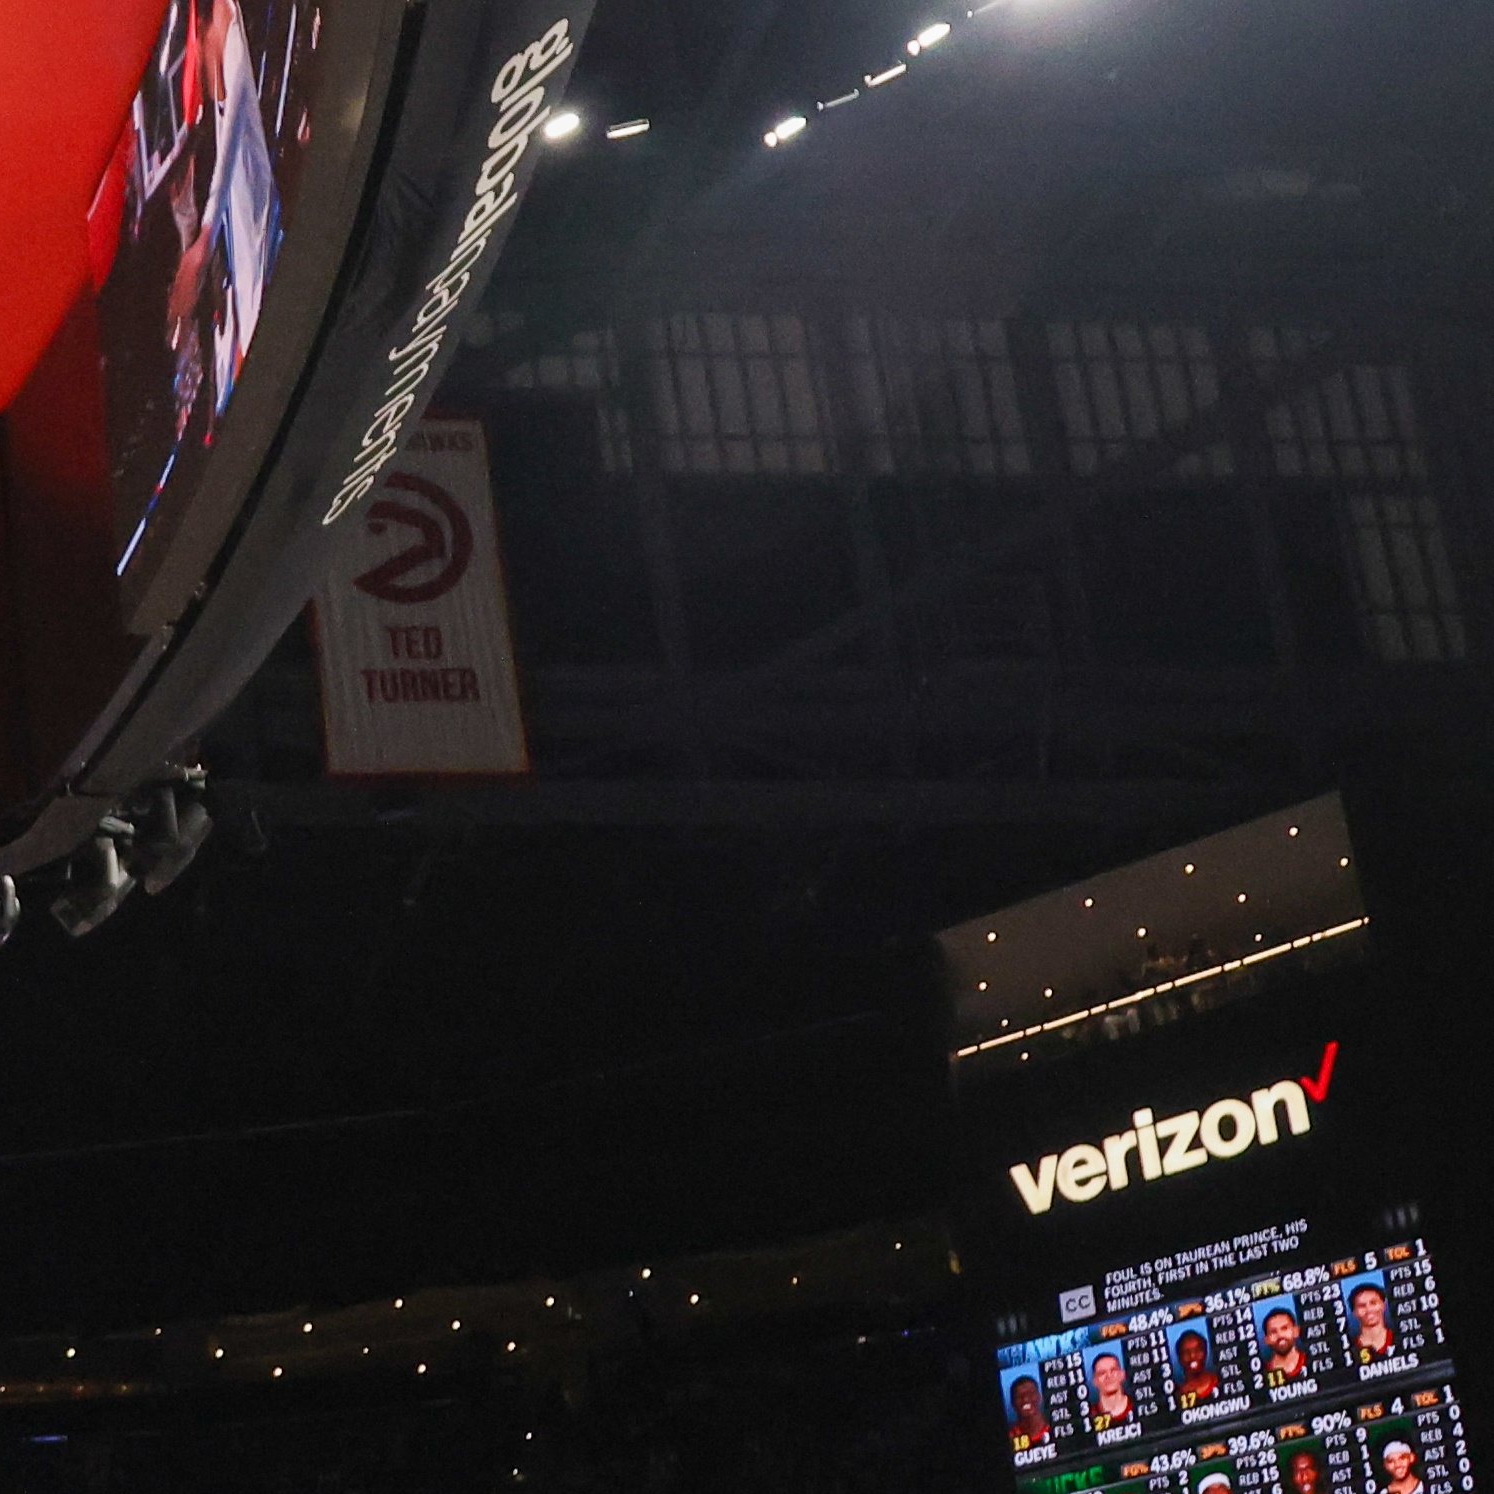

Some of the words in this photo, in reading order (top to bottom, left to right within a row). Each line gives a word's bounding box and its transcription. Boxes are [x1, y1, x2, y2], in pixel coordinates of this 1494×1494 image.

[323, 18, 571, 525] globalpayments
[389, 625, 443, 660] TED
[362, 667, 481, 703] TURNER
[1009, 1077, 1313, 1216] verizon
[1105, 1266, 1138, 1286] FOUL
[1139, 1261, 1154, 1276] IS
[1154, 1256, 1173, 1273] ON
[1174, 1239, 1231, 1269] TAUREAN
[1285, 1218, 1308, 1236] HIS
[1158, 1265, 1193, 1286] FIRST
[1195, 1260, 1210, 1276] IN
[1212, 1251, 1238, 1270] THE
[1239, 1243, 1270, 1263] LAST
[1271, 1235, 1300, 1255] TWO
[1413, 1258, 1433, 1277] 15
[1128, 1307, 1174, 1333] 48.4%
[1204, 1287, 1251, 1314] 36.1%
[1281, 1264, 1331, 1293] 68.8%
[1363, 1251, 1378, 1271] 5
[1414, 1237, 1428, 1257] 1
[1424, 1275, 1436, 1292] 6
[1065, 1294, 1092, 1313] CC
[1419, 1292, 1441, 1312] 10
[1267, 1369, 1286, 1386] 11
[1359, 1352, 1420, 1381] DANIELS
[1180, 1391, 1198, 1410] 17
[1267, 1378, 1318, 1404] YOUNG
[1093, 1413, 1112, 1432] 27
[1181, 1394, 1252, 1426] OKONGWU
[1096, 1421, 1142, 1447] KREJCI
[1150, 1447, 1197, 1472] 43.6%
[1227, 1428, 1277, 1456] 39.6%
[1310, 1409, 1353, 1436] 90%
[1390, 1396, 1406, 1417] 4
[1442, 1384, 1455, 1404] 1
[1013, 1434, 1031, 1451] 18
[1013, 1442, 1058, 1468] GUEYE
[1257, 1448, 1278, 1467] 26
